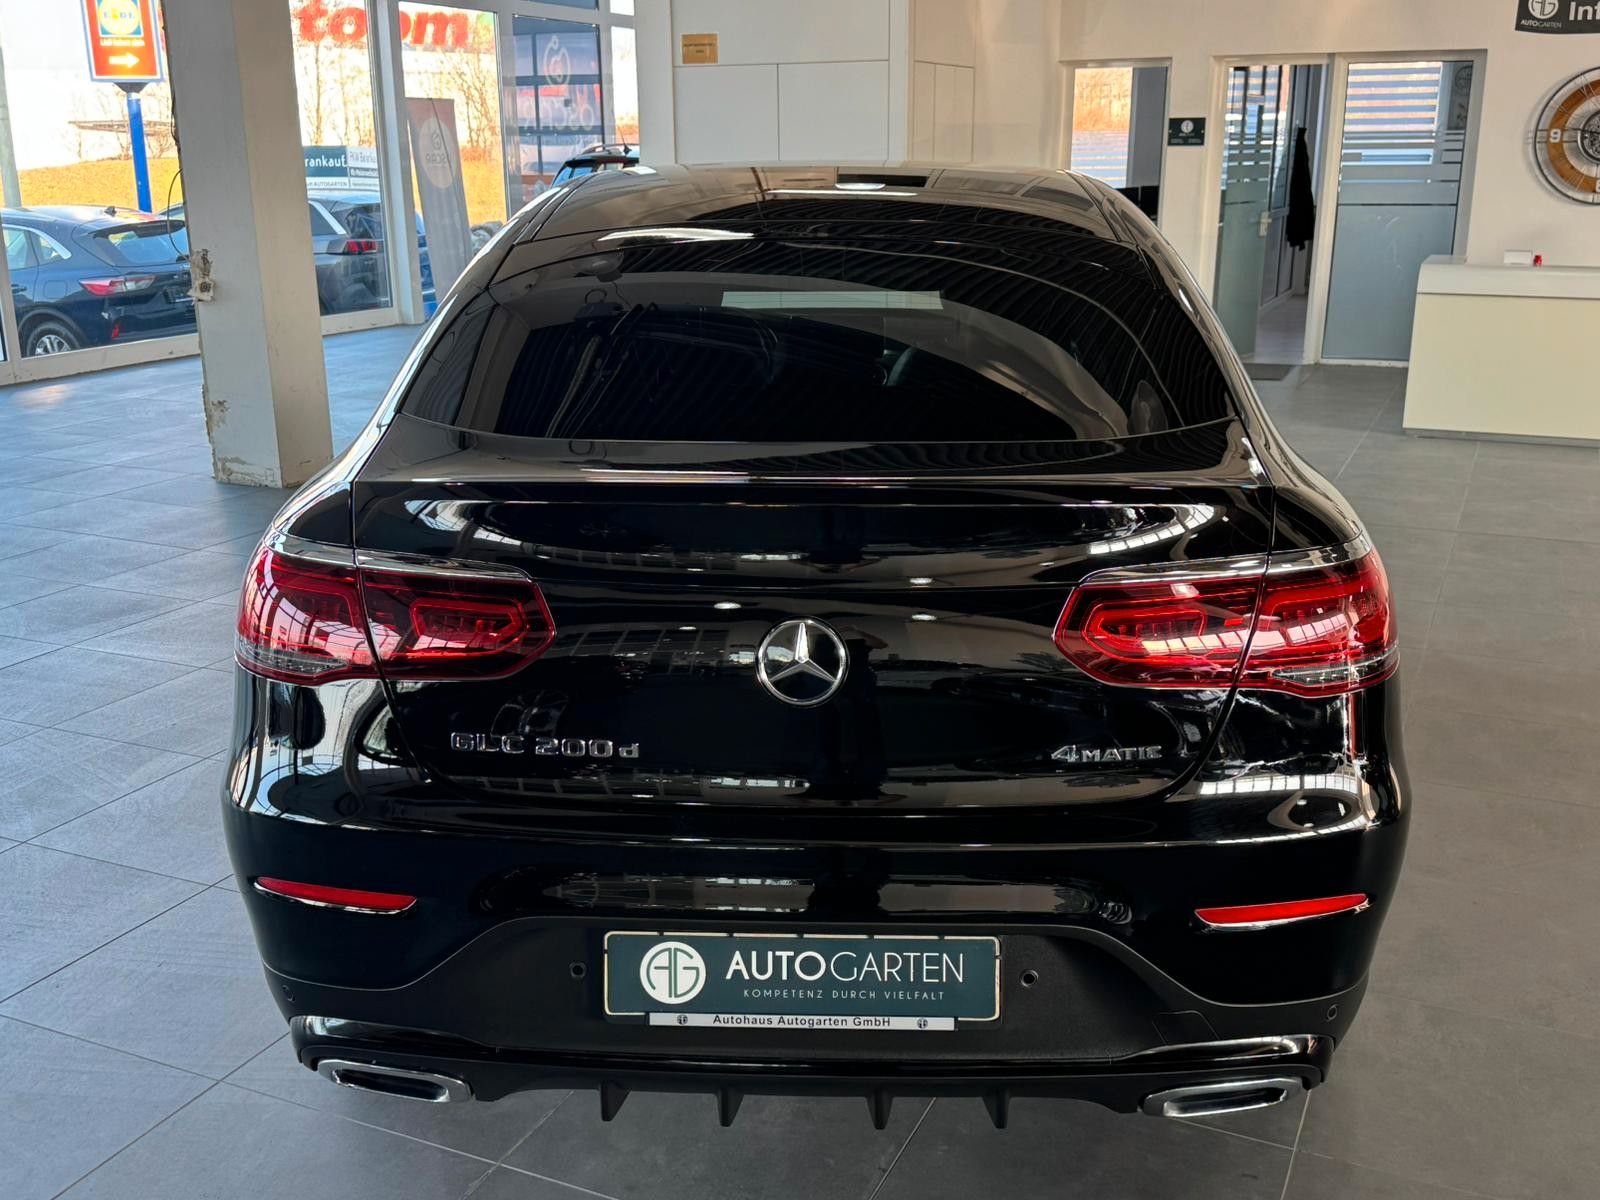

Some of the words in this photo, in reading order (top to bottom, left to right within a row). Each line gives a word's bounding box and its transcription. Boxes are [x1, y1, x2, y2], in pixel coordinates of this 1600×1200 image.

[293, 0, 469, 47] tom
[451, 732, 525, 754] GLC
[1051, 744, 1162, 762] 4MATIC
[725, 950, 963, 983] AUTOGARTEN
[743, 989, 824, 999] KOMPETENZ
[832, 989, 876, 999] DURCH
[884, 991, 944, 1000] VIELFALT
[713, 1014, 773, 1025] Autohaus
[777, 1016, 848, 1028] Autogarten
[853, 1016, 891, 1027] GmbH
